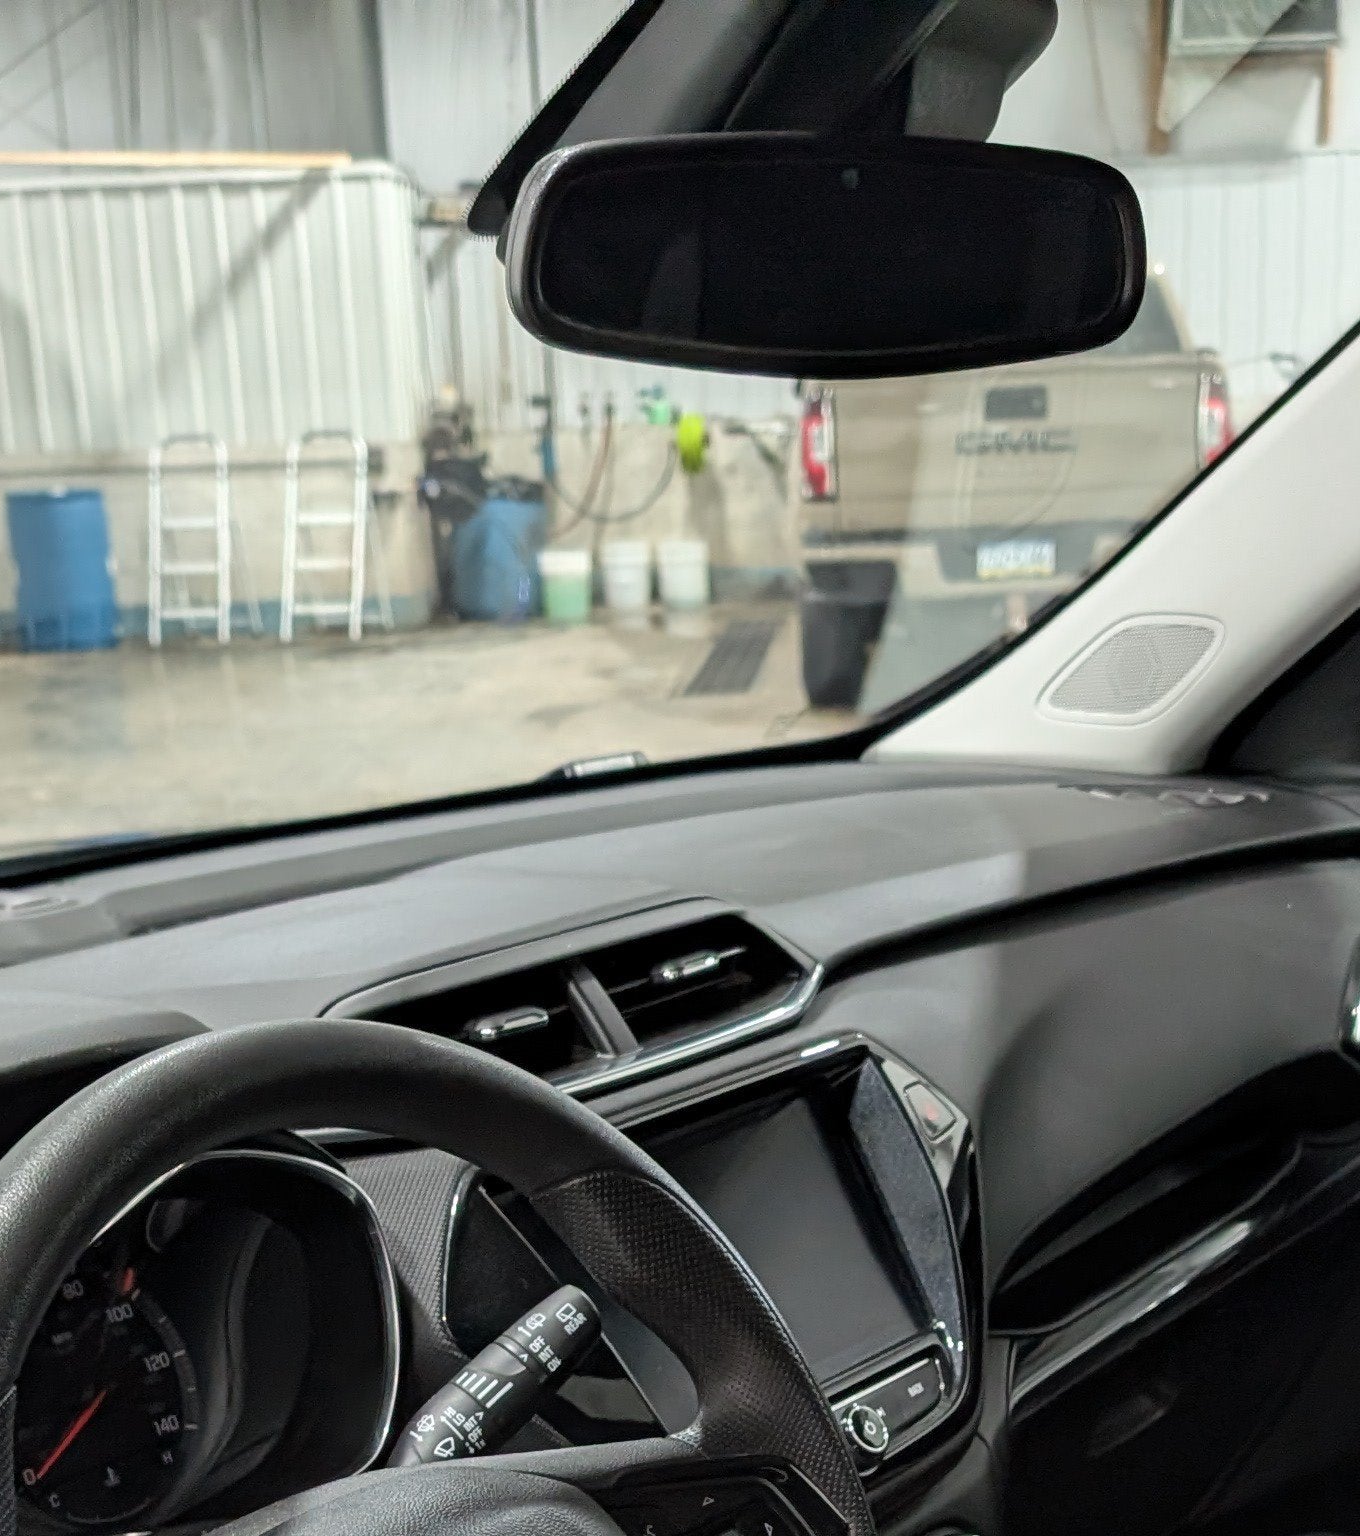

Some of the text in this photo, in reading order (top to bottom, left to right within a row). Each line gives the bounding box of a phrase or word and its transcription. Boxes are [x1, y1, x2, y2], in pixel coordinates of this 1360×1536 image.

[105, 1303, 133, 1323] 100
[529, 1335, 546, 1353] OFF
[144, 1351, 170, 1372] 120
[153, 1414, 180, 1436] 140
